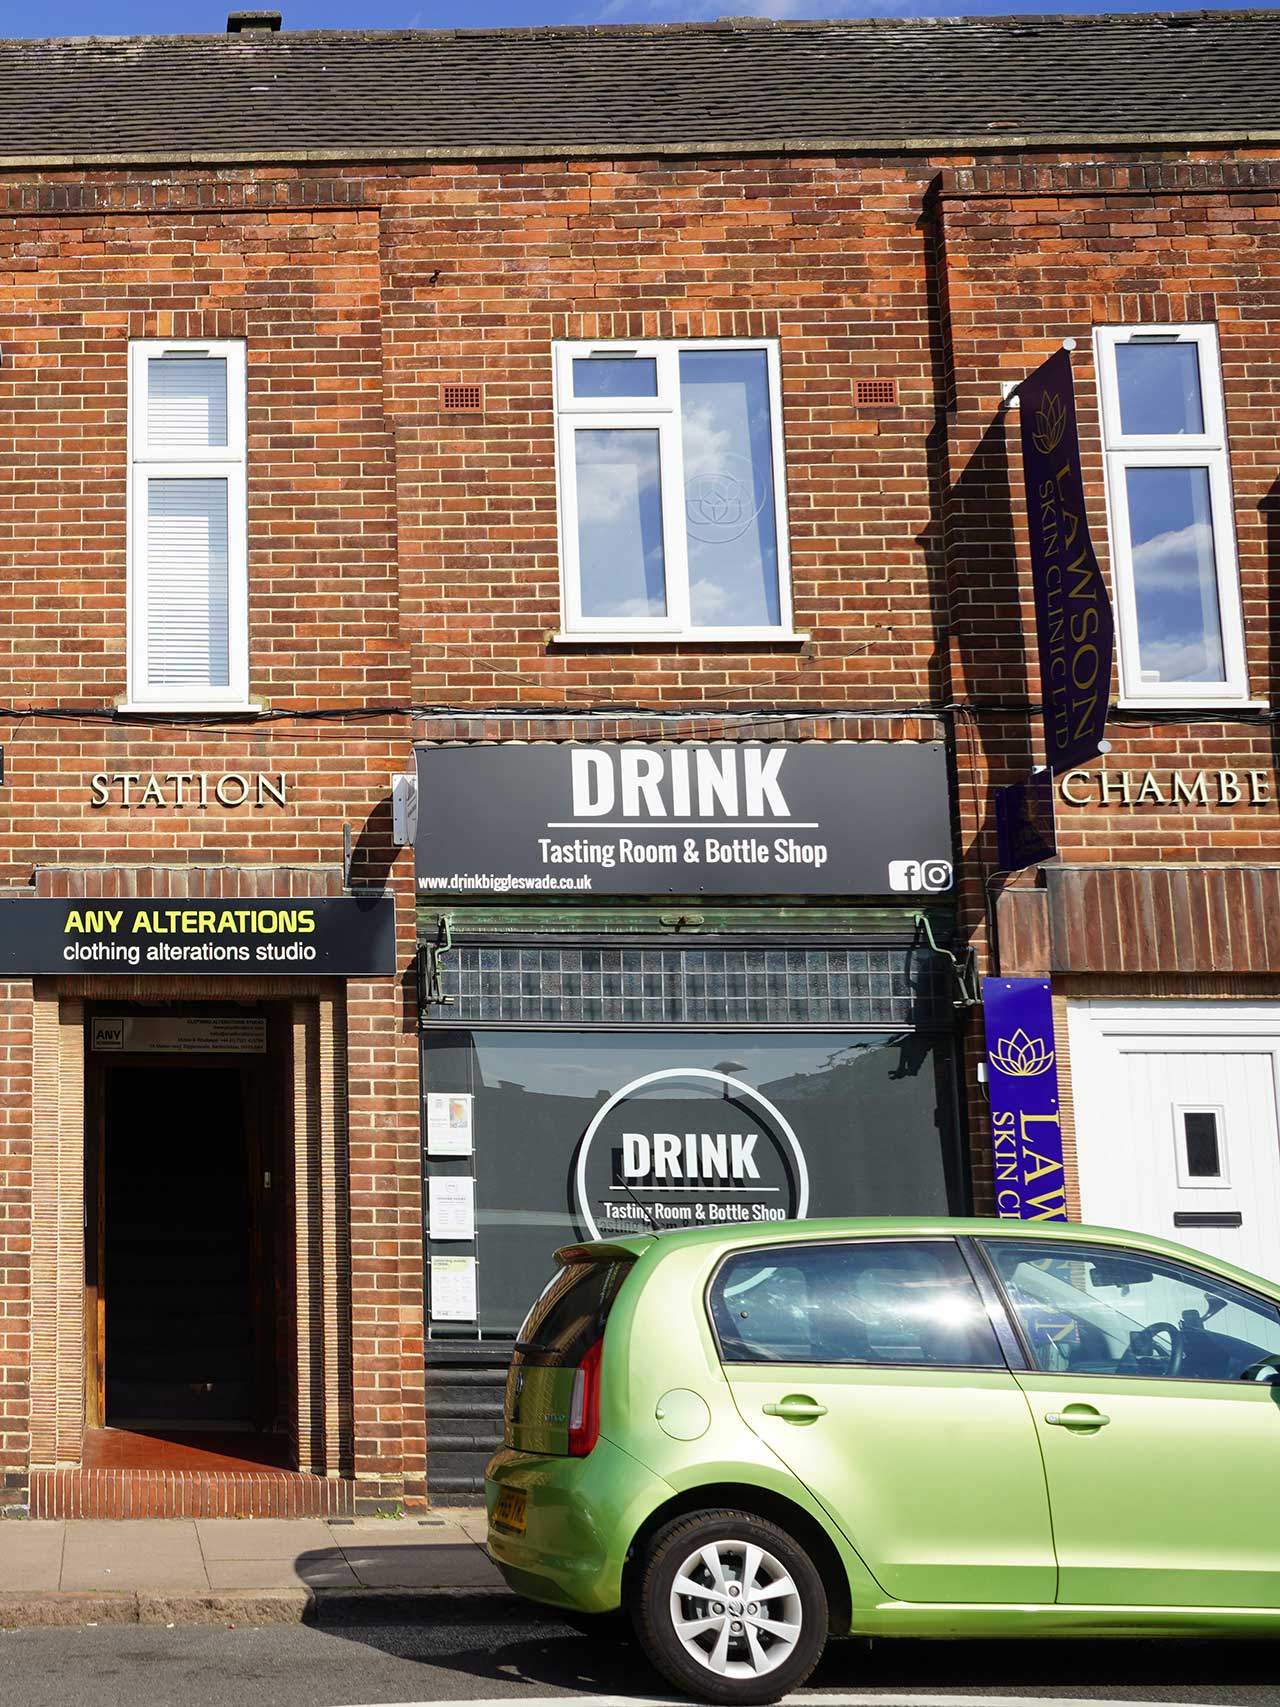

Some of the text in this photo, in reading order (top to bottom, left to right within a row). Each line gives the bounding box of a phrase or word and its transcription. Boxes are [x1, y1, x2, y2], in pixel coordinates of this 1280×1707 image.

[1037, 479, 1069, 749] SKIN CLINIC LTD
[1056, 460, 1099, 741] LAWSON
[91, 772, 287, 807] STATION
[571, 748, 791, 817] DRINK
[1061, 770, 1271, 804] CHAMBE
[538, 838, 828, 868] Tasting Room & Bottle Shop
[419, 874, 592, 892] www.drinkbiggleswade.co.uk
[64, 910, 316, 933] ANY ALTERATIONS
[63, 942, 317, 964] clothing alterations studio
[96, 1030, 121, 1040] ANY
[622, 1133, 761, 1179] DRINK
[992, 1111, 1019, 1182] SKIN
[604, 1202, 653, 1221] Tasting
[655, 1203, 692, 1220] Room
[695, 1204, 706, 1220] &
[709, 1204, 749, 1220] Bottle
